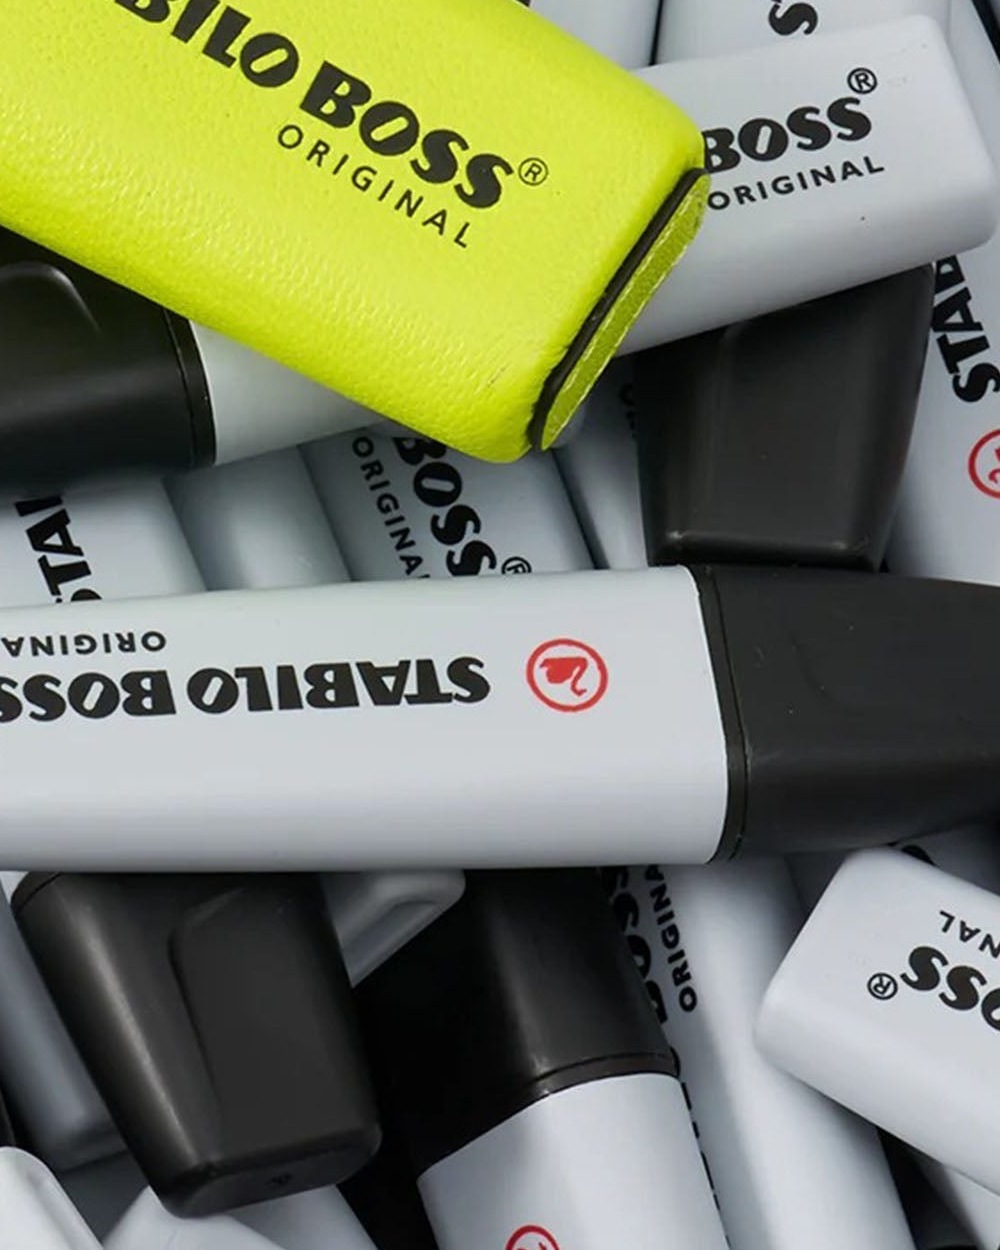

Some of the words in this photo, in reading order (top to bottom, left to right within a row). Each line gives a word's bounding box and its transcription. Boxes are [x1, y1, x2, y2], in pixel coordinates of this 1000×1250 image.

[276, 124, 471, 249] ORIGINAL
[706, 154, 886, 211] ORIGINAL
[351, 435, 431, 579] ORIGINA
[186, 655, 492, 715] STABILO
